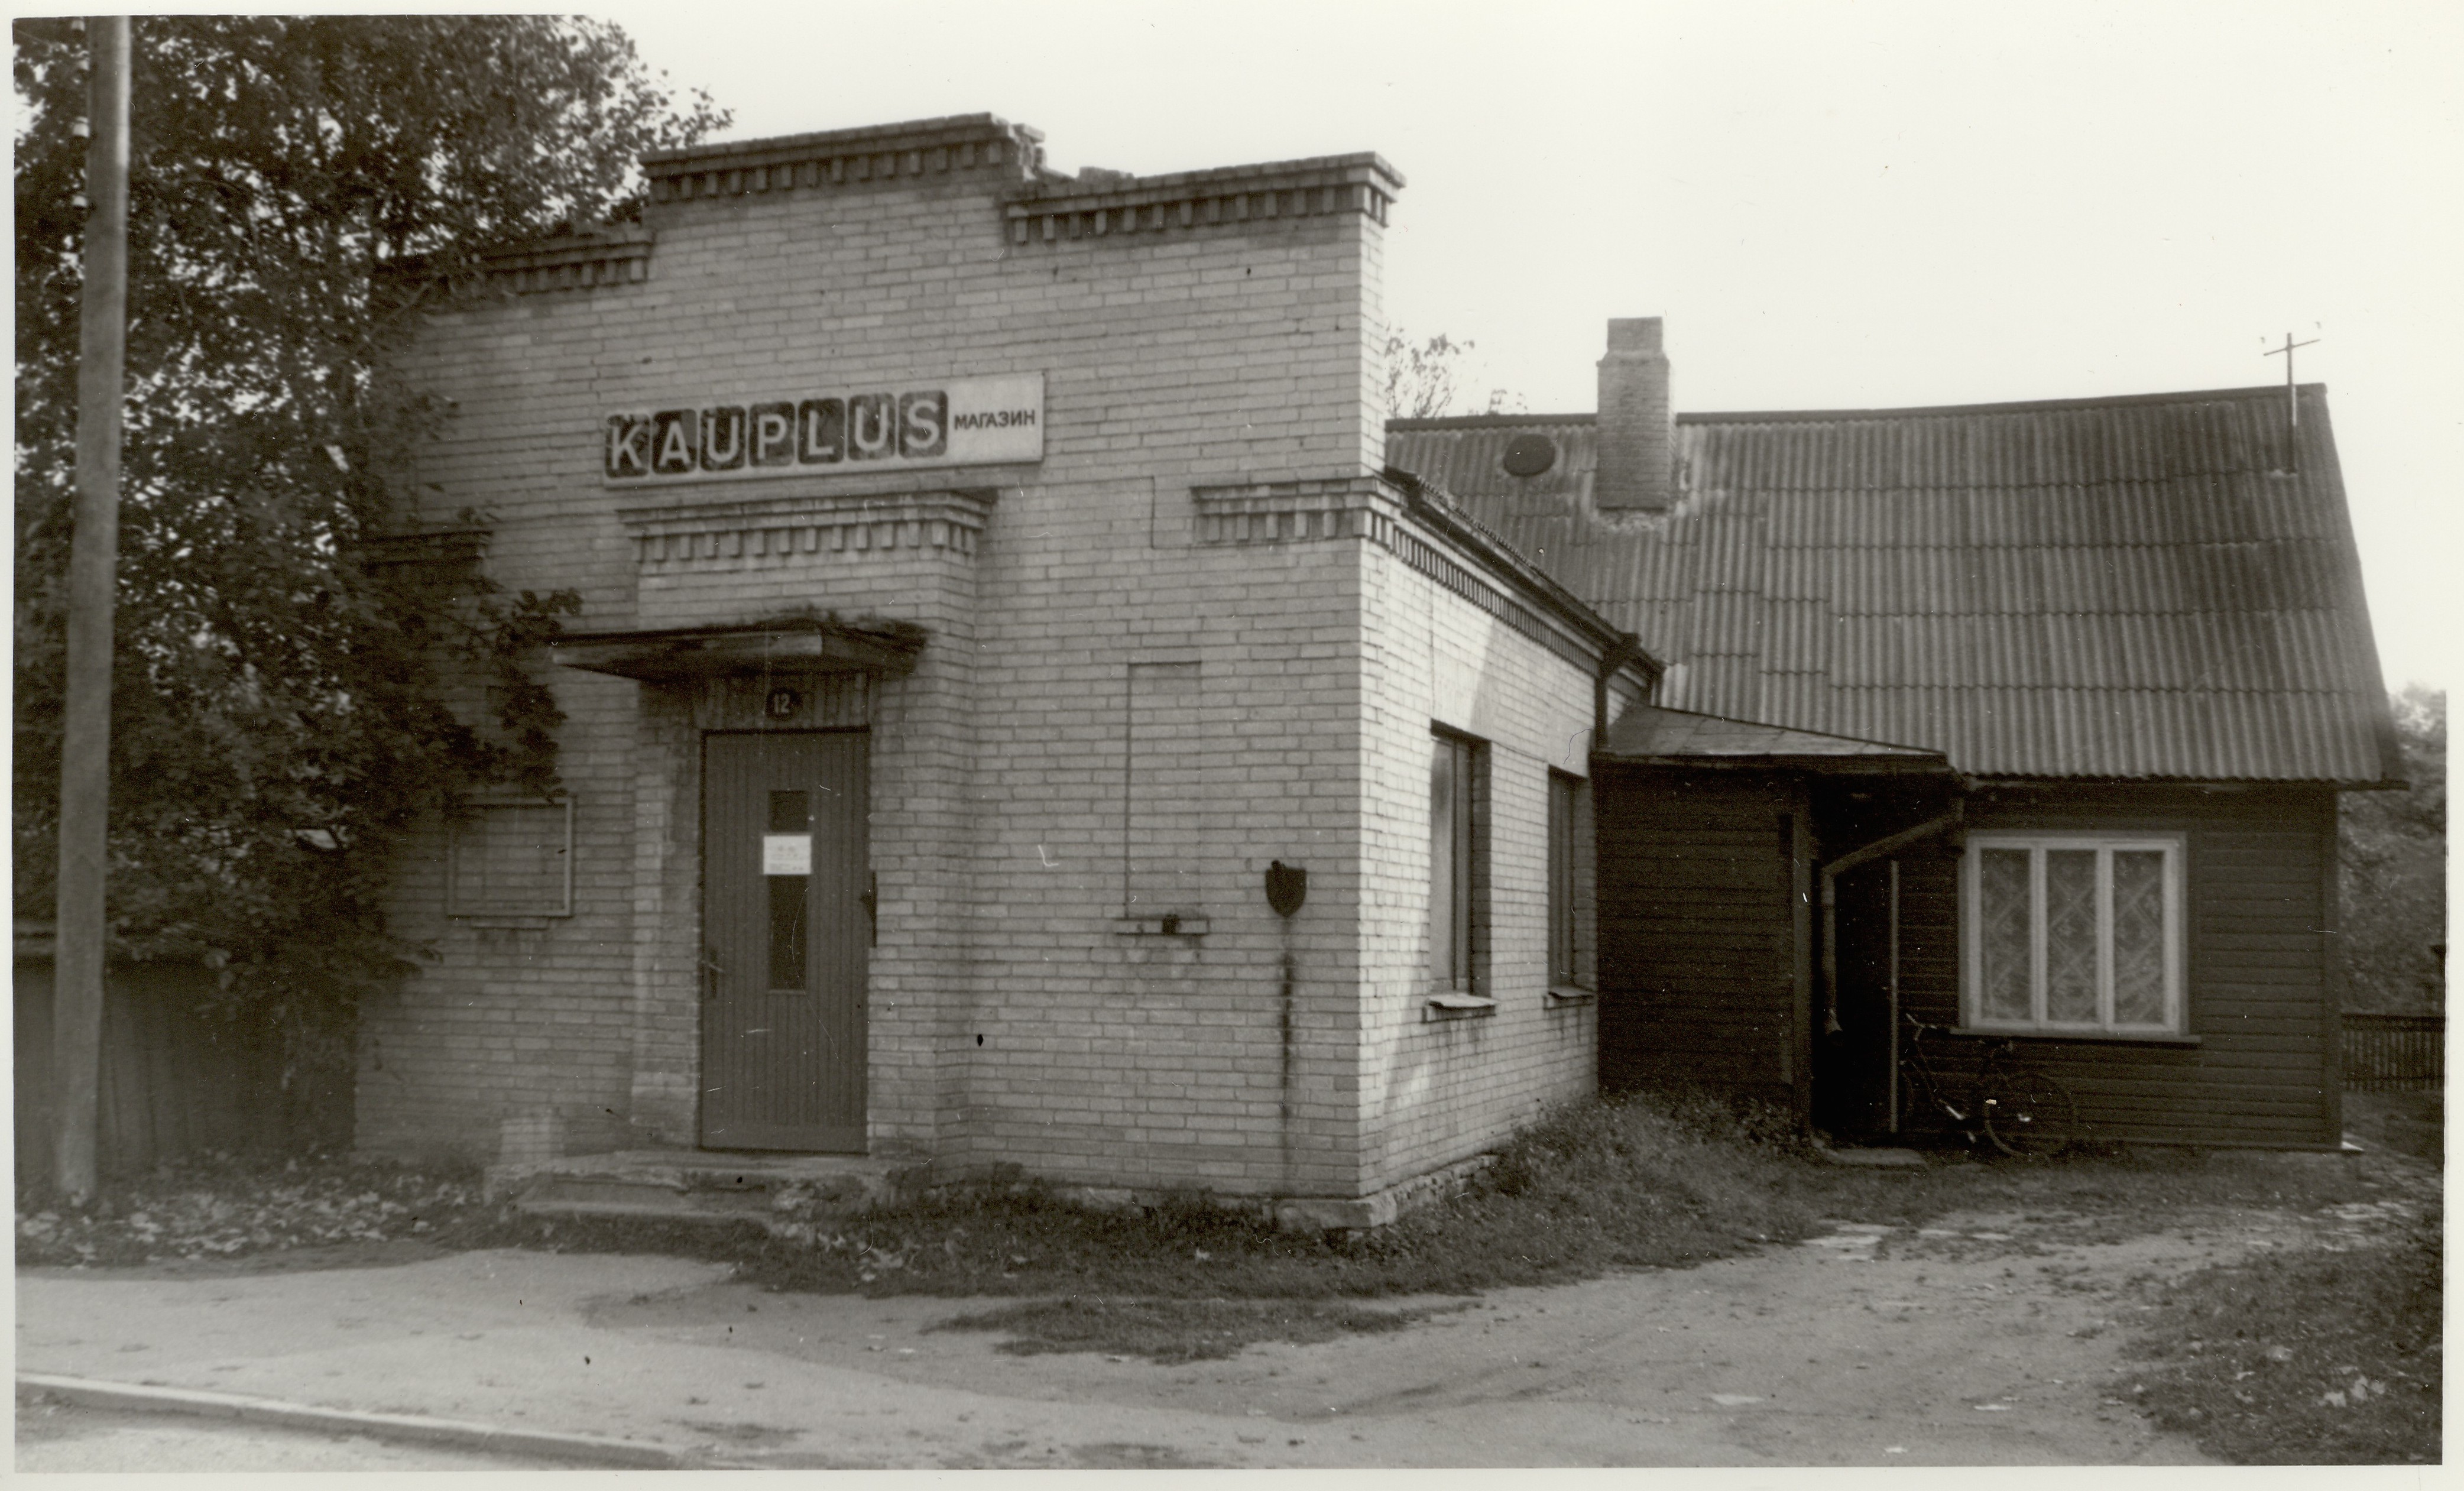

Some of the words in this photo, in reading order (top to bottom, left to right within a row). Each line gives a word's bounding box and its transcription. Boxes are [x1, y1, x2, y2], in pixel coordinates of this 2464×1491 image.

[954, 409, 1036, 430] МАГАЗИН
[609, 400, 939, 471] KAUPLUS
[773, 693, 790, 714] 12
